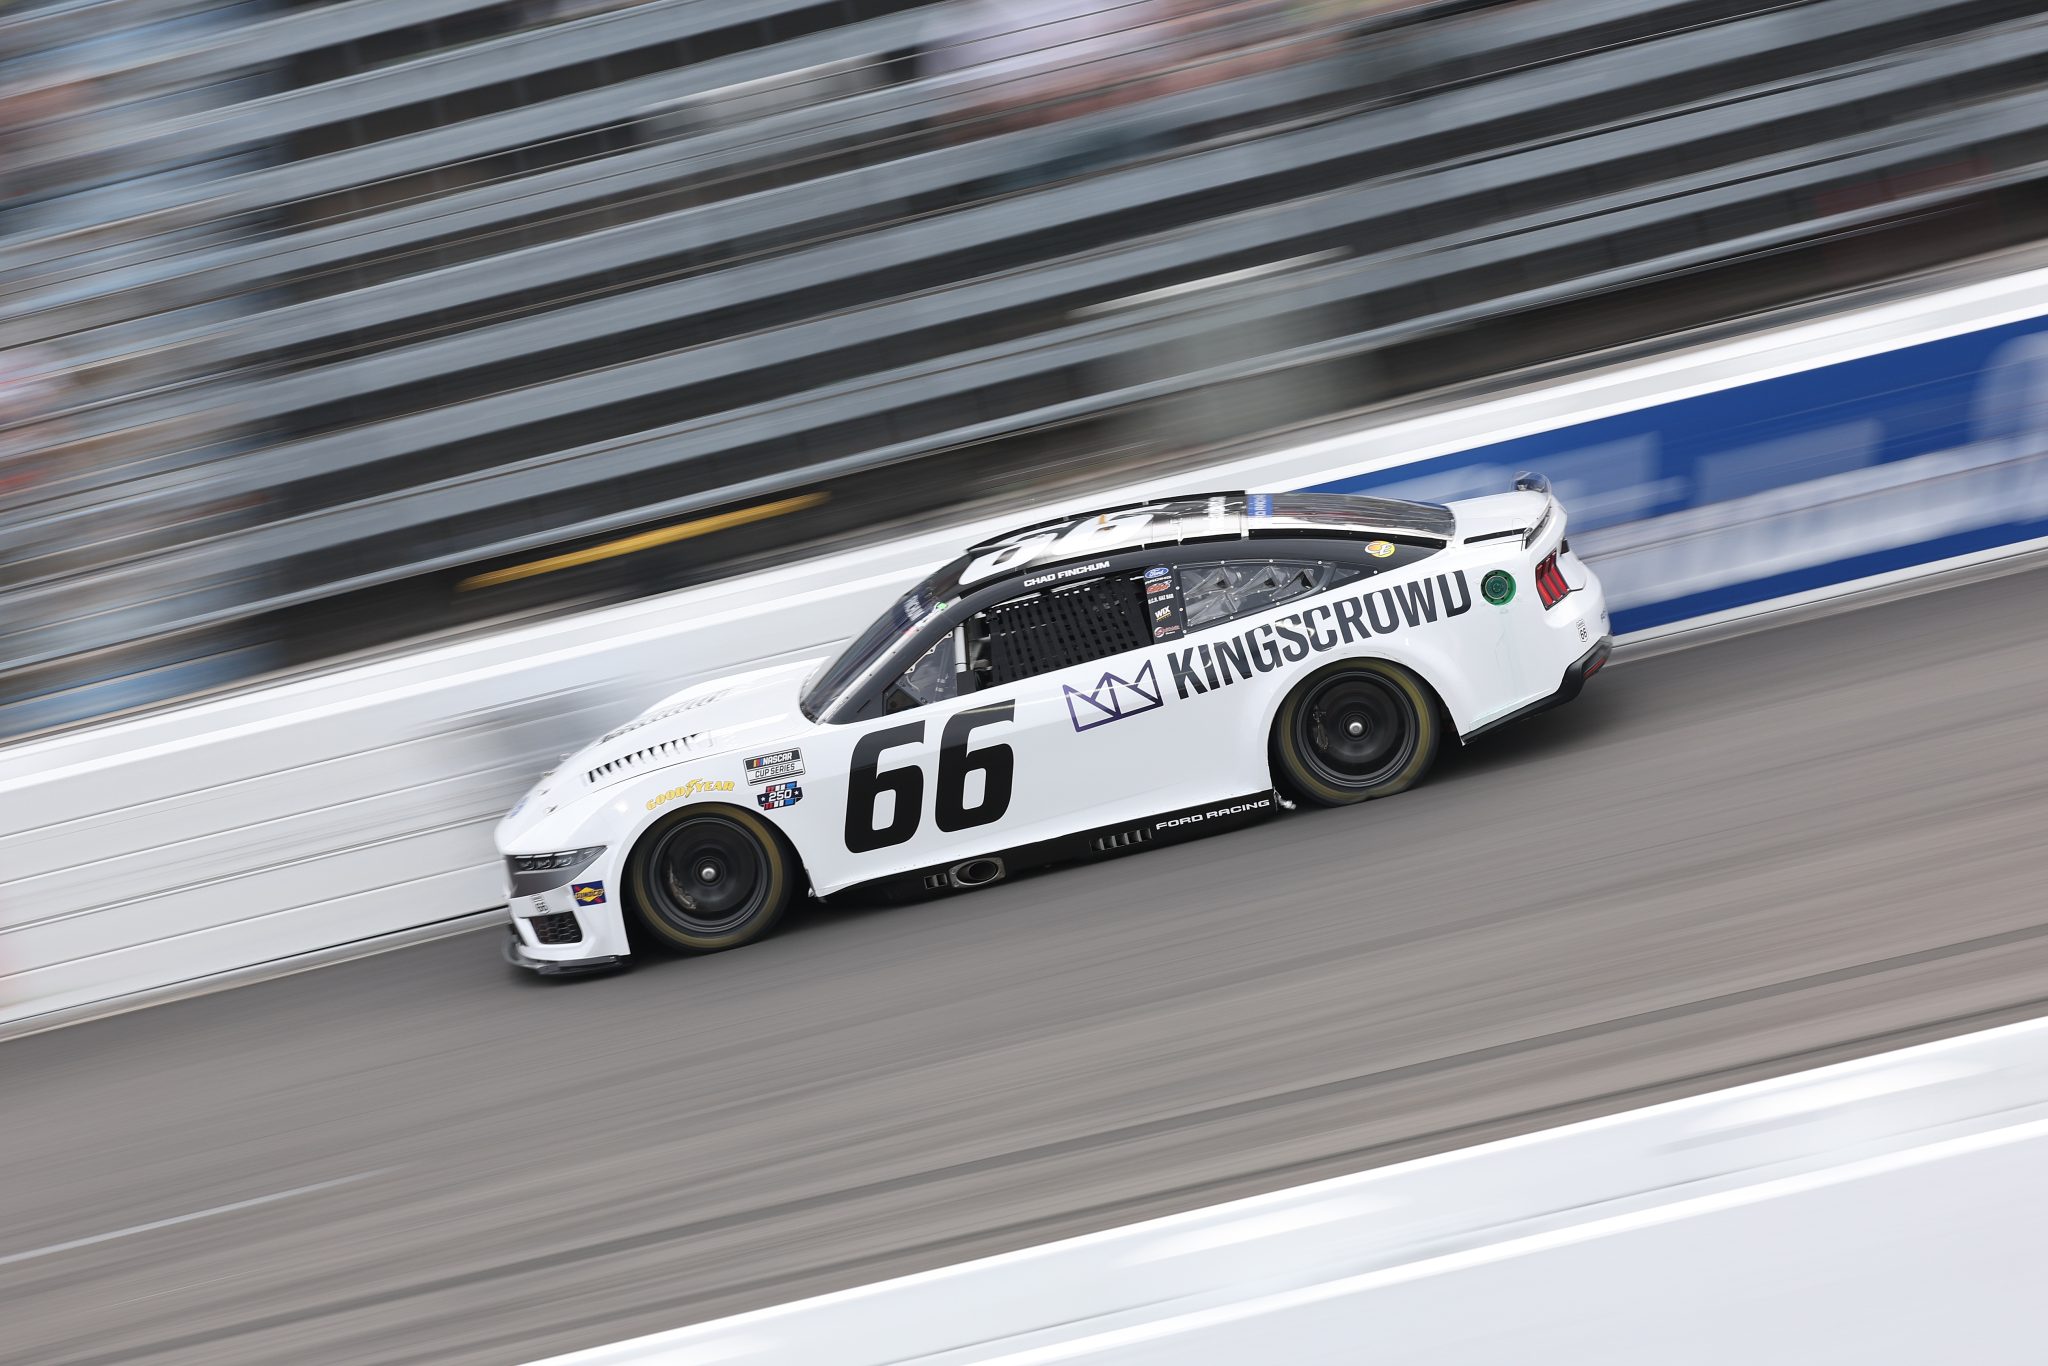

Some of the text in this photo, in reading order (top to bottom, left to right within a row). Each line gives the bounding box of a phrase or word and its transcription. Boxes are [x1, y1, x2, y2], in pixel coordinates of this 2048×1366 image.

[1024, 561, 1110, 588] CHAD FINCHUM
[1155, 605, 1171, 618] WIX
[1167, 569, 1471, 699] KINGSCROWD
[755, 763, 795, 778] CUP SERIES
[762, 752, 792, 765] NASCAR
[844, 698, 1015, 853] 66
[646, 778, 735, 810] GOODYEAR
[768, 788, 792, 801] 250
[1156, 799, 1270, 830] FORD RACING
